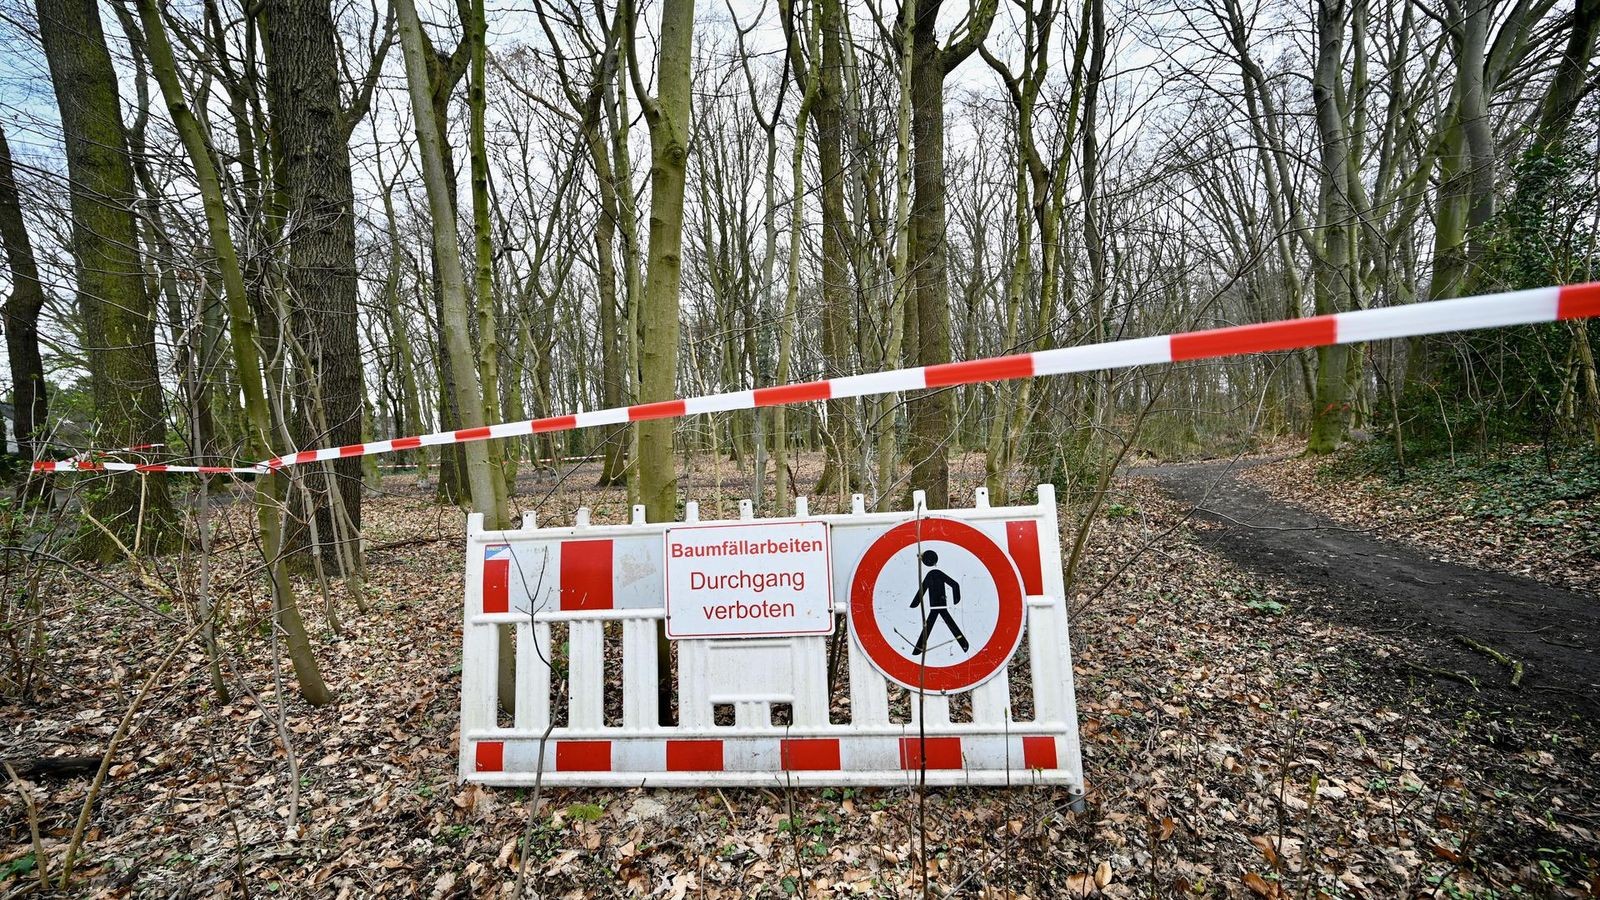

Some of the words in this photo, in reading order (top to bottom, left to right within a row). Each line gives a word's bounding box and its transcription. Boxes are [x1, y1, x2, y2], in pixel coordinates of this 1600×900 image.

[671, 538, 823, 558] Baumfällarbeiten
[690, 570, 805, 592] Durchgang
[703, 600, 795, 620] verboten
